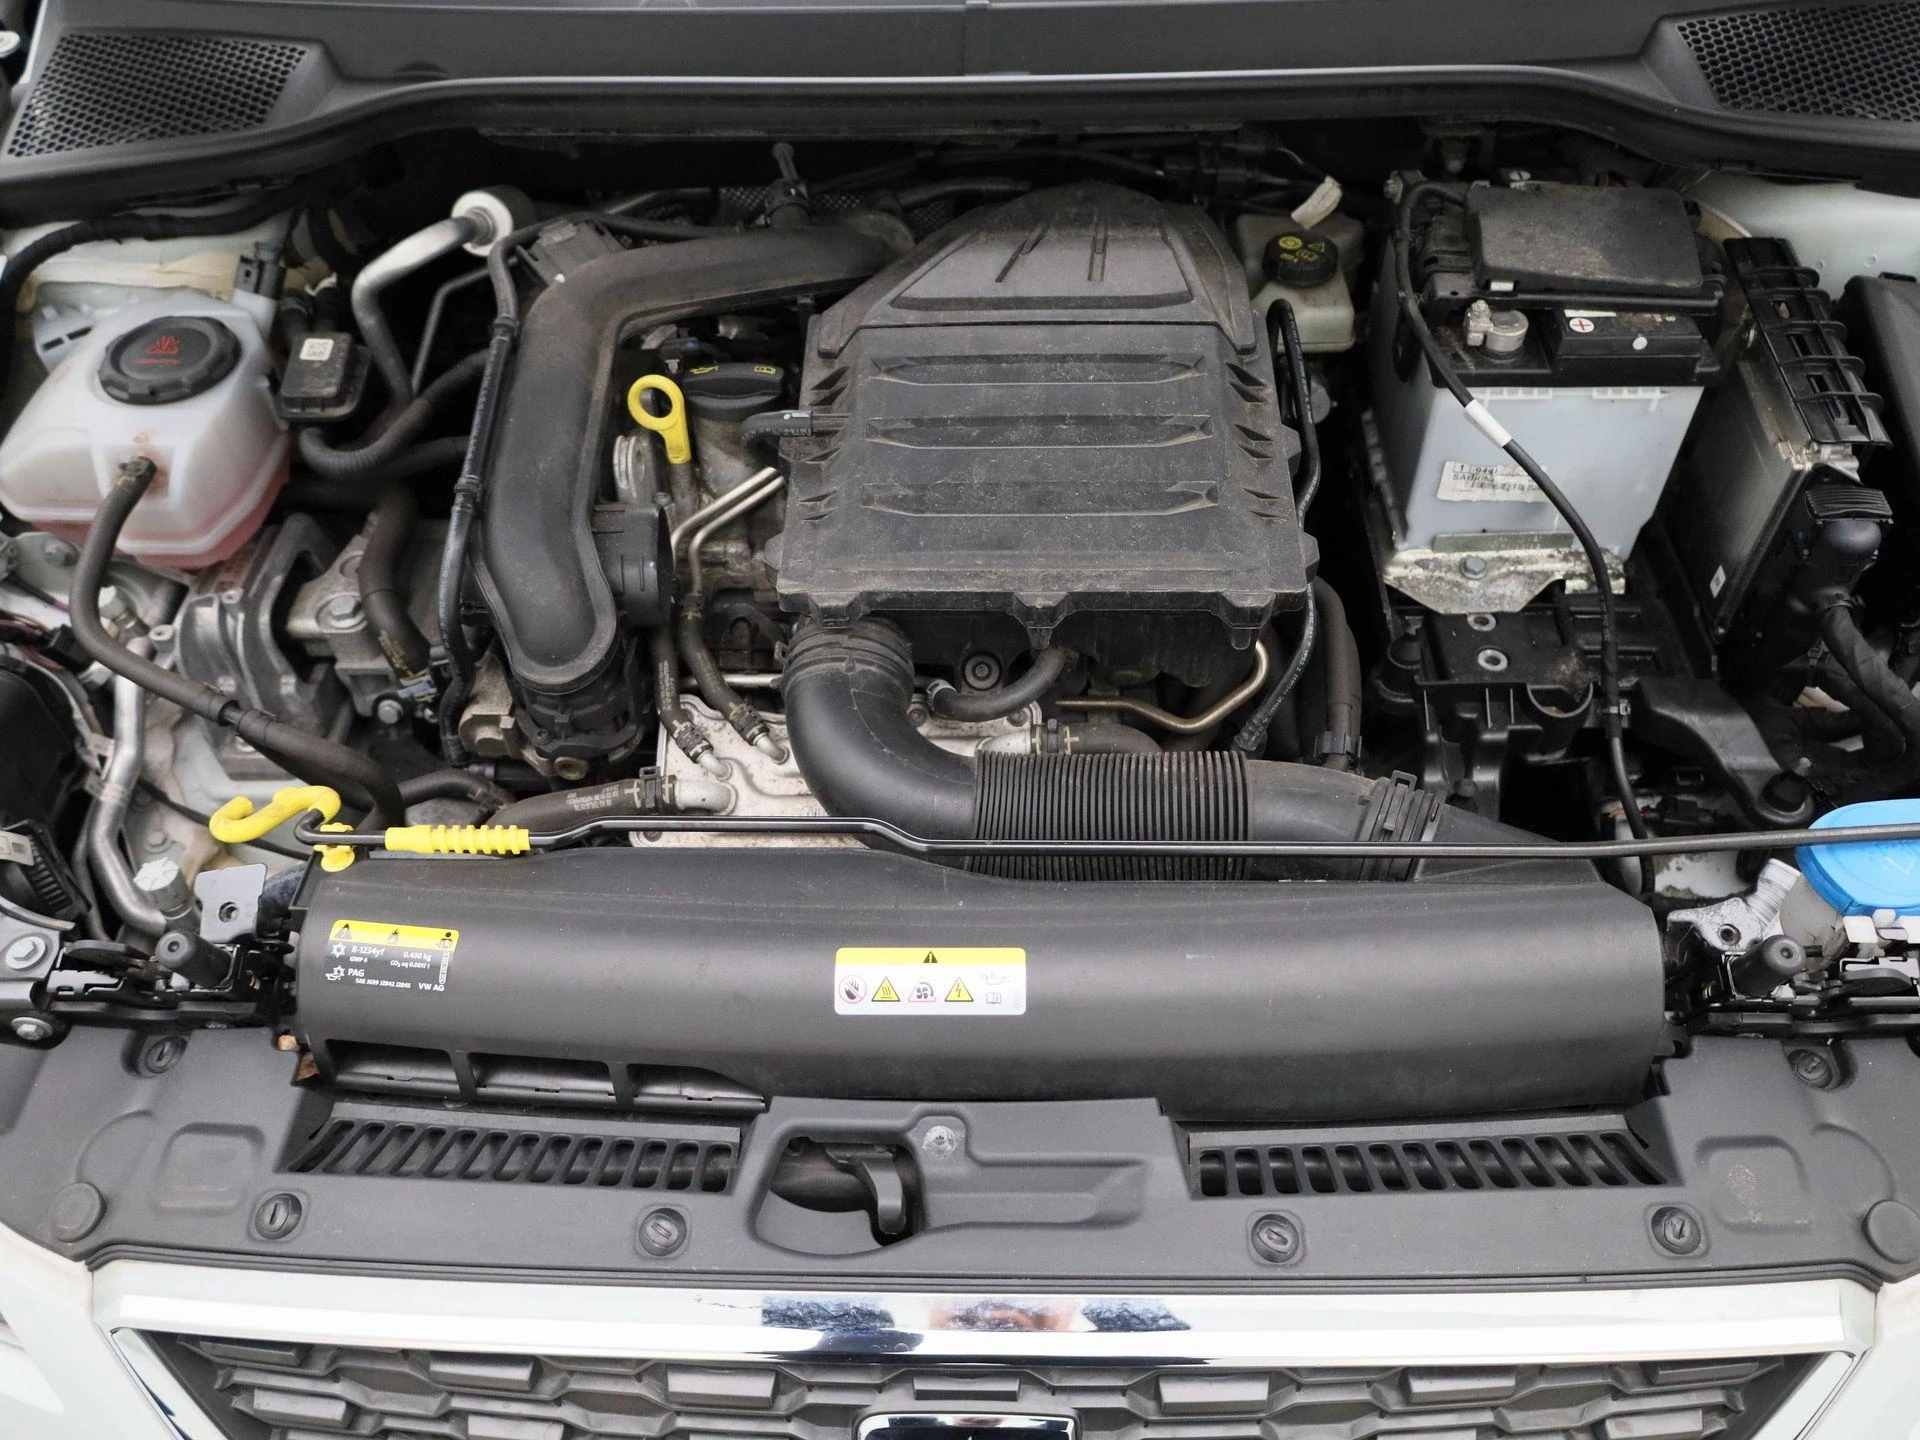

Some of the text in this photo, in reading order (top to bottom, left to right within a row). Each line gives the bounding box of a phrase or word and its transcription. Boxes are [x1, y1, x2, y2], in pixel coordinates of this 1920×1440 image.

[352, 946, 432, 962] R-1234yf 0.430 kg
[347, 968, 365, 977] PAG
[418, 982, 432, 990] VW
[432, 984, 445, 992] AG
